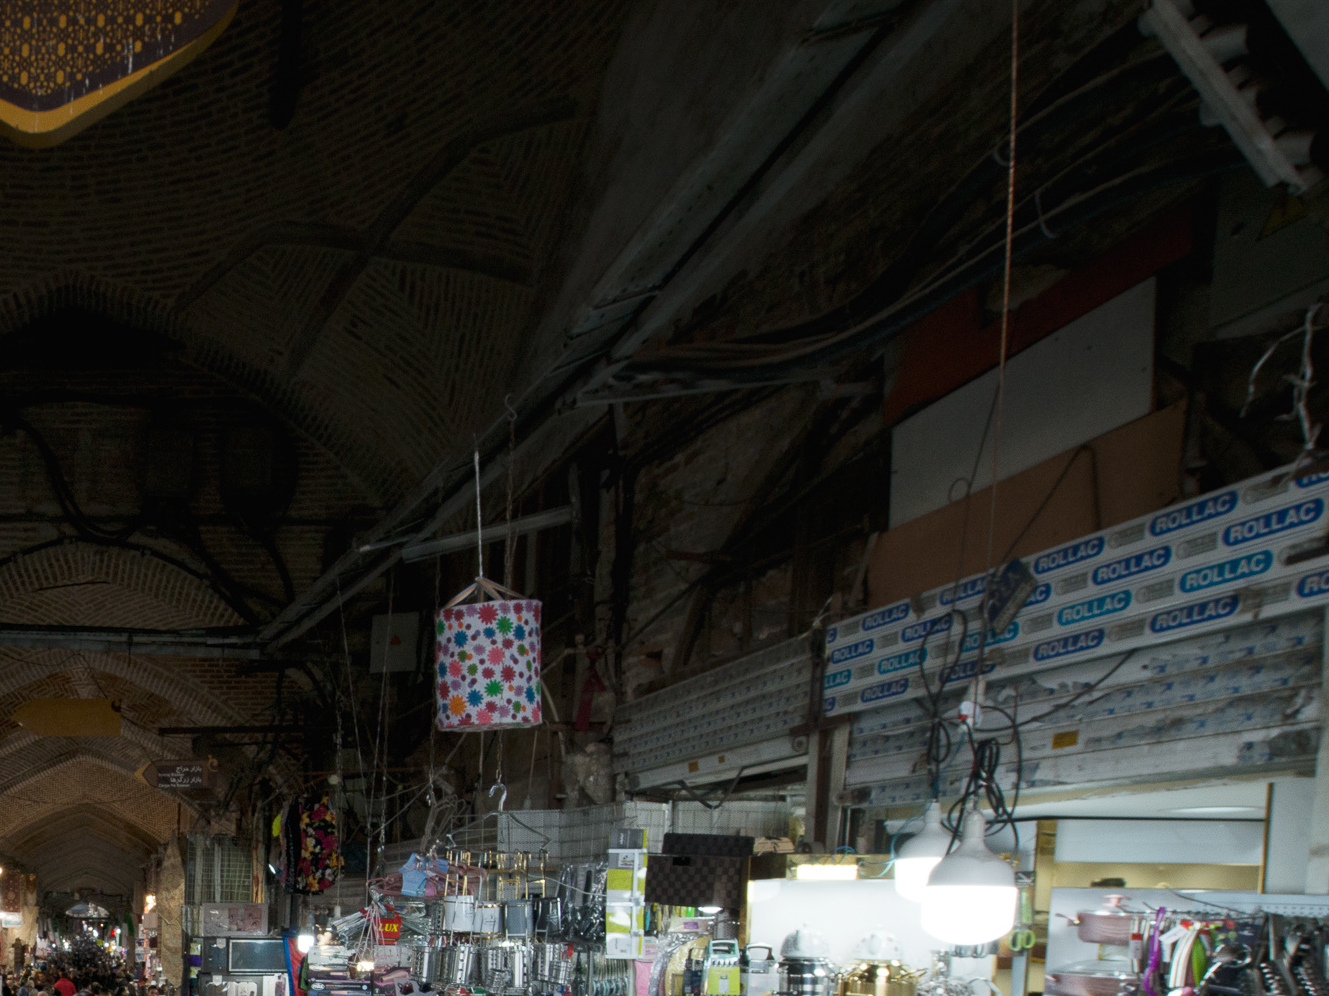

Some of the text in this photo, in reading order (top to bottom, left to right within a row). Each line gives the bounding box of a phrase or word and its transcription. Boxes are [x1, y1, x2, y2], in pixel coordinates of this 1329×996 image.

[834, 641, 873, 662] ROLLAC
[1096, 548, 1168, 583] ROLLAC
[1228, 502, 1318, 544] ROLLAC
[865, 605, 907, 629] ROLLAC
[943, 578, 987, 602] ROLLA
[1037, 538, 1103, 573] ROLLAC
[1155, 495, 1235, 534] ROLLAC
[880, 650, 923, 672] ROLLAC
[1061, 592, 1128, 622] ROLLAC
[1184, 553, 1269, 591] ROLLAC
[863, 680, 905, 701] ROLLAC
[1035, 629, 1103, 660] ROLLAC
[1155, 596, 1235, 631] ROLLAC
[378, 922, 399, 933] LUX
